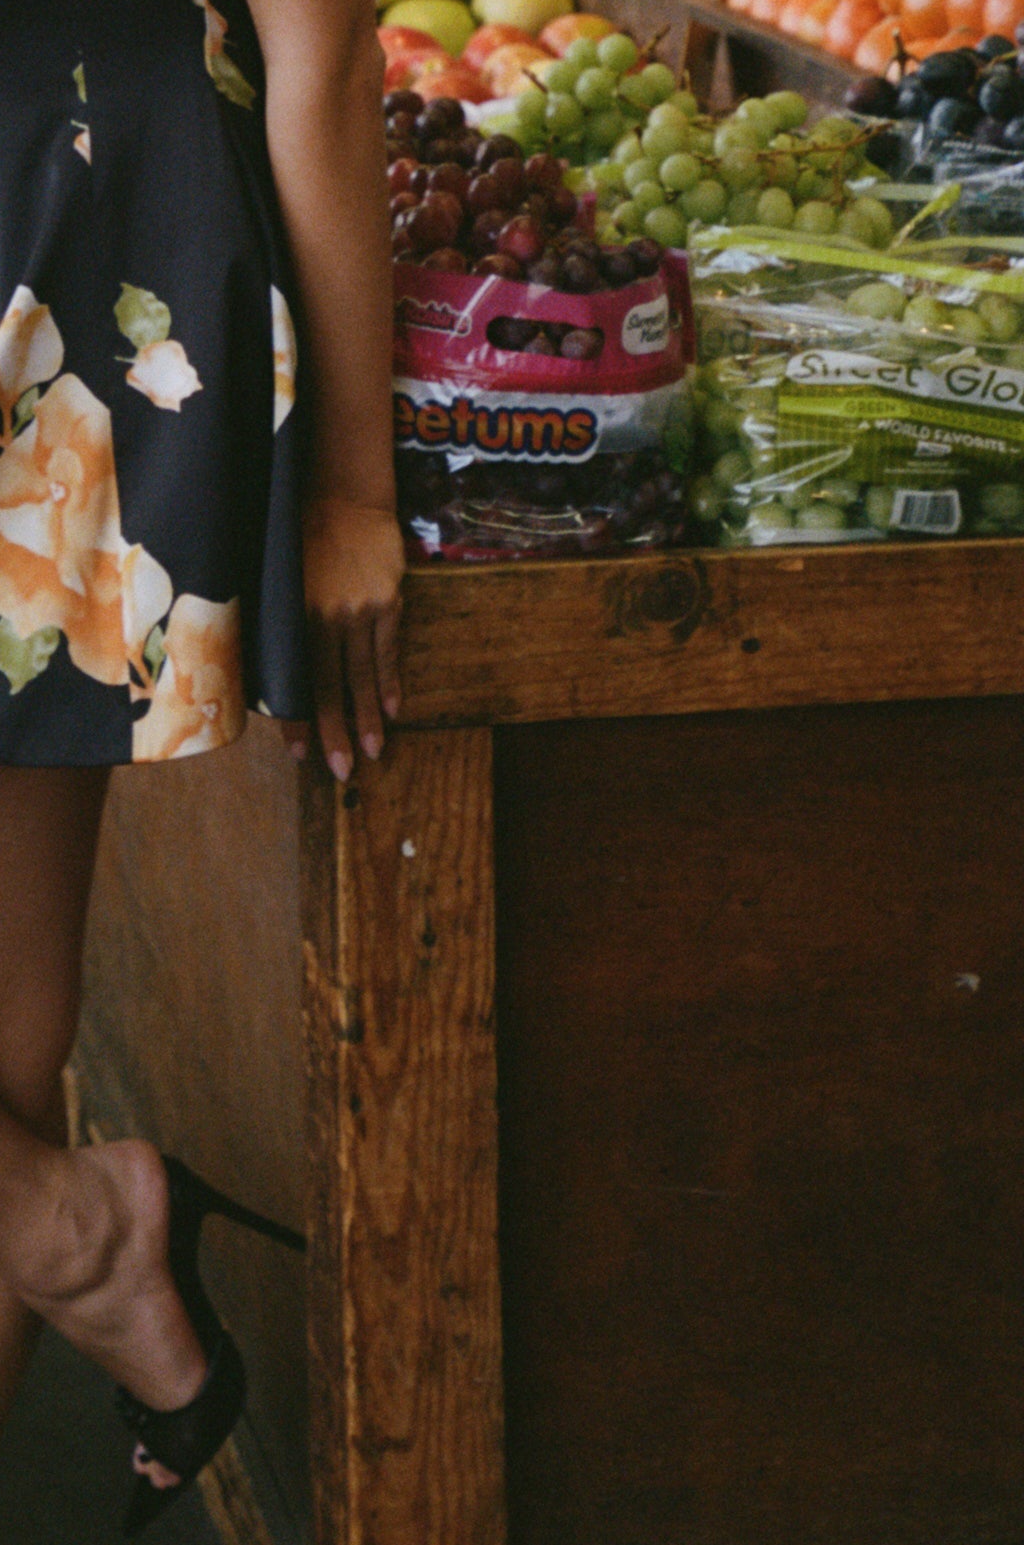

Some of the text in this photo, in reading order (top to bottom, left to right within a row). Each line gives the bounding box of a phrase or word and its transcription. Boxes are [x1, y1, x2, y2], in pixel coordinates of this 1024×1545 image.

[945, 364, 1024, 405] Glo
[874, 418, 931, 441] WORLD
[933, 428, 1007, 453] FAVORITE
